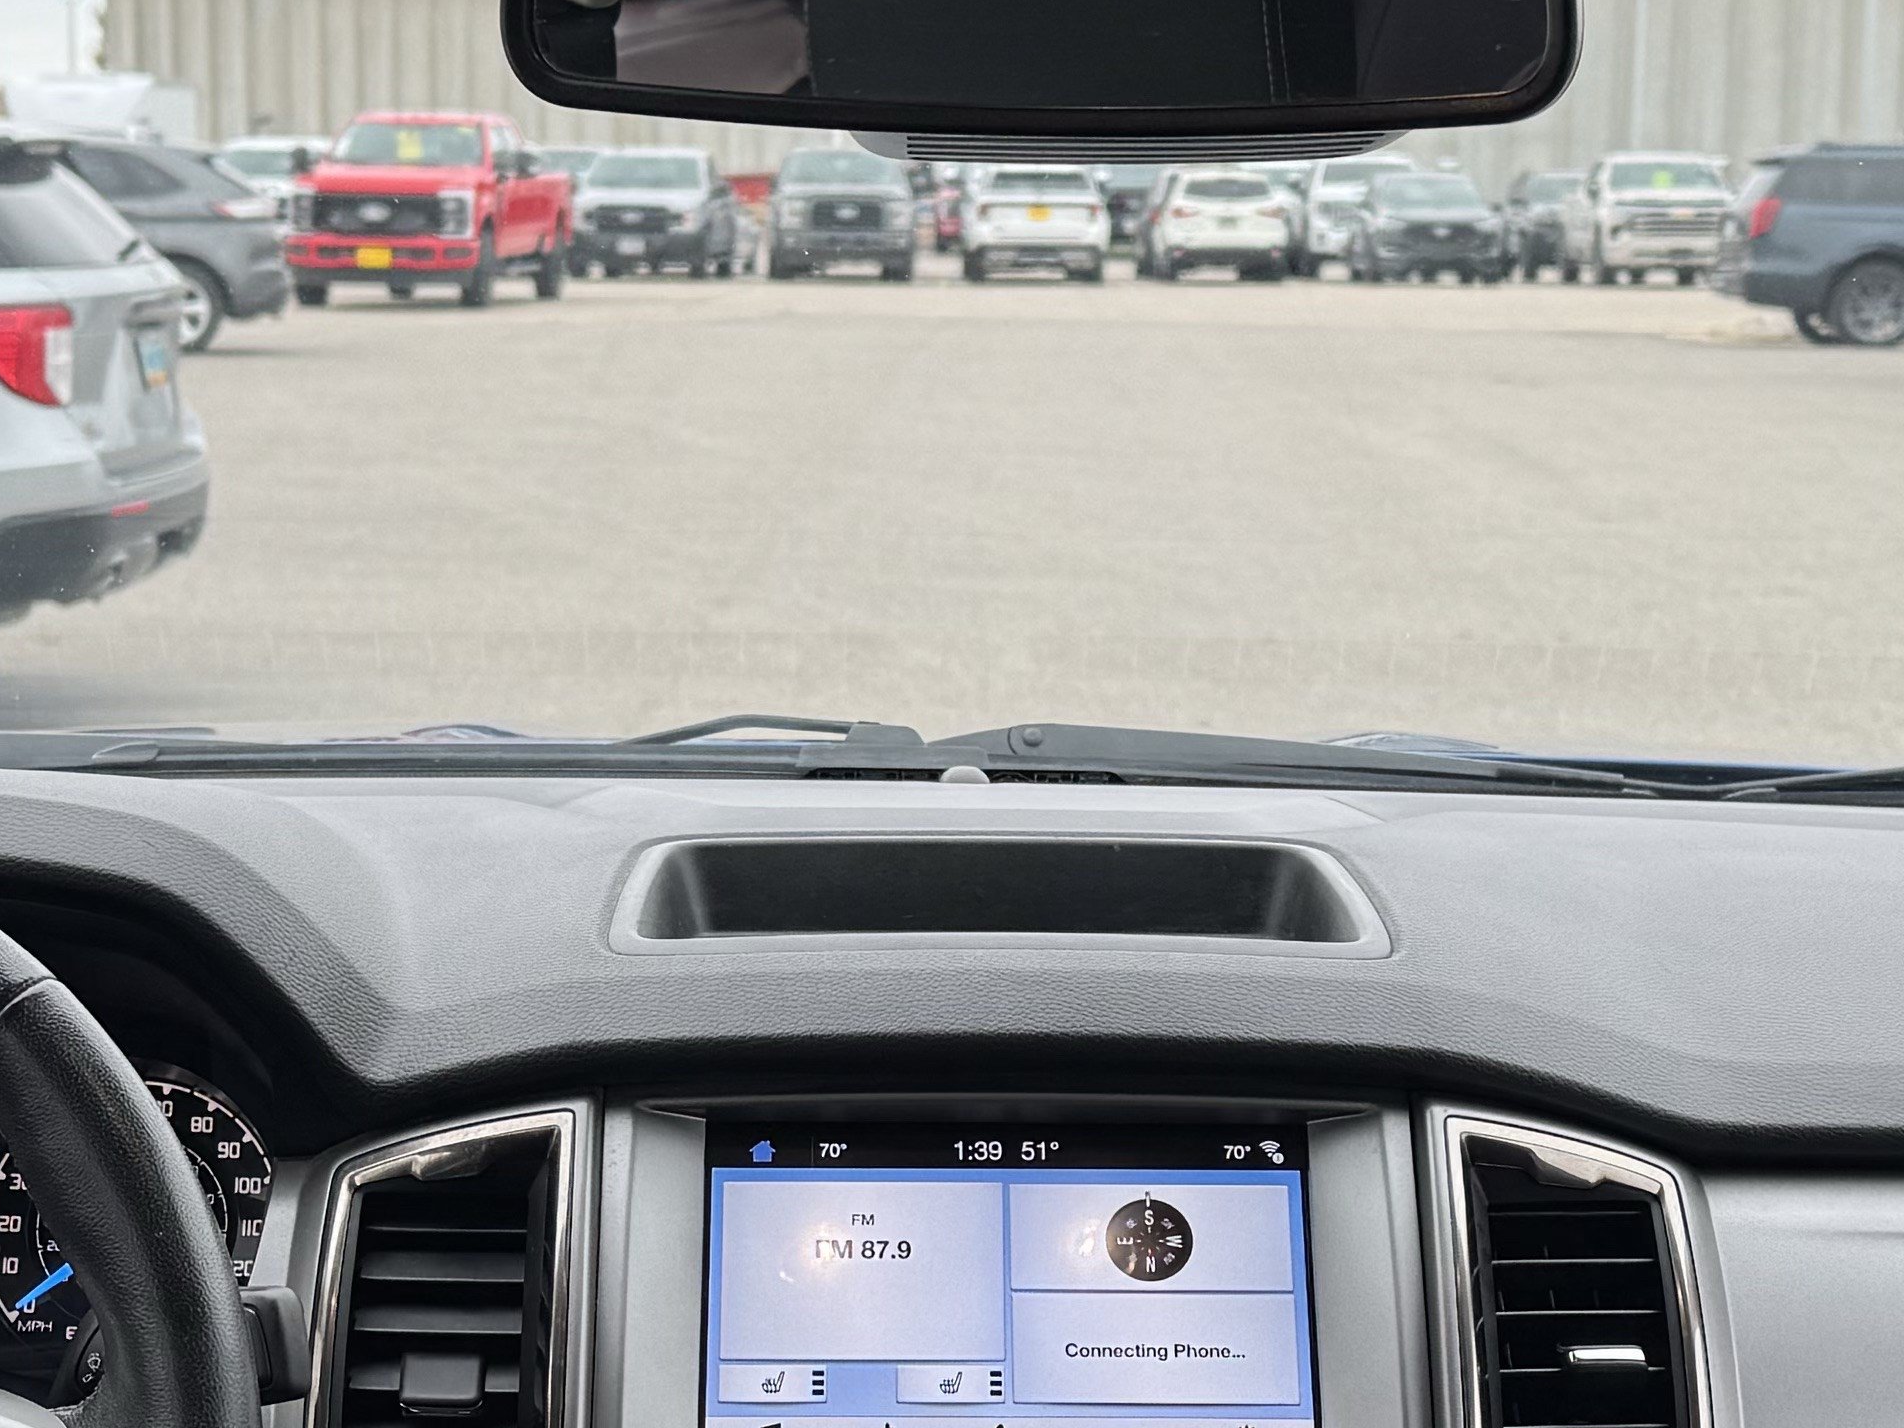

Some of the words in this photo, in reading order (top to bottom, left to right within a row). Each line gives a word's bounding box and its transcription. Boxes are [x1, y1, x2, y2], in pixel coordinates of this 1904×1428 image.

[190, 1116, 214, 1134] 80
[217, 1141, 241, 1159] 90
[819, 1142, 848, 1158] 70°
[953, 1140, 1003, 1161] 1:39
[1021, 1141, 1060, 1161] 51°
[1223, 1144, 1252, 1160] 70°
[234, 1177, 262, 1194] 100
[851, 1213, 875, 1226] FM
[1144, 1210, 1154, 1225] S
[861, 1239, 912, 1260] 87.9
[2, 1256, 20, 1275] 10
[1145, 1255, 1156, 1273] N
[17, 1320, 53, 1332] MPH
[65, 1326, 78, 1340] E
[1065, 1342, 1168, 1361] Connecting
[1174, 1343, 1247, 1360] Phone...
